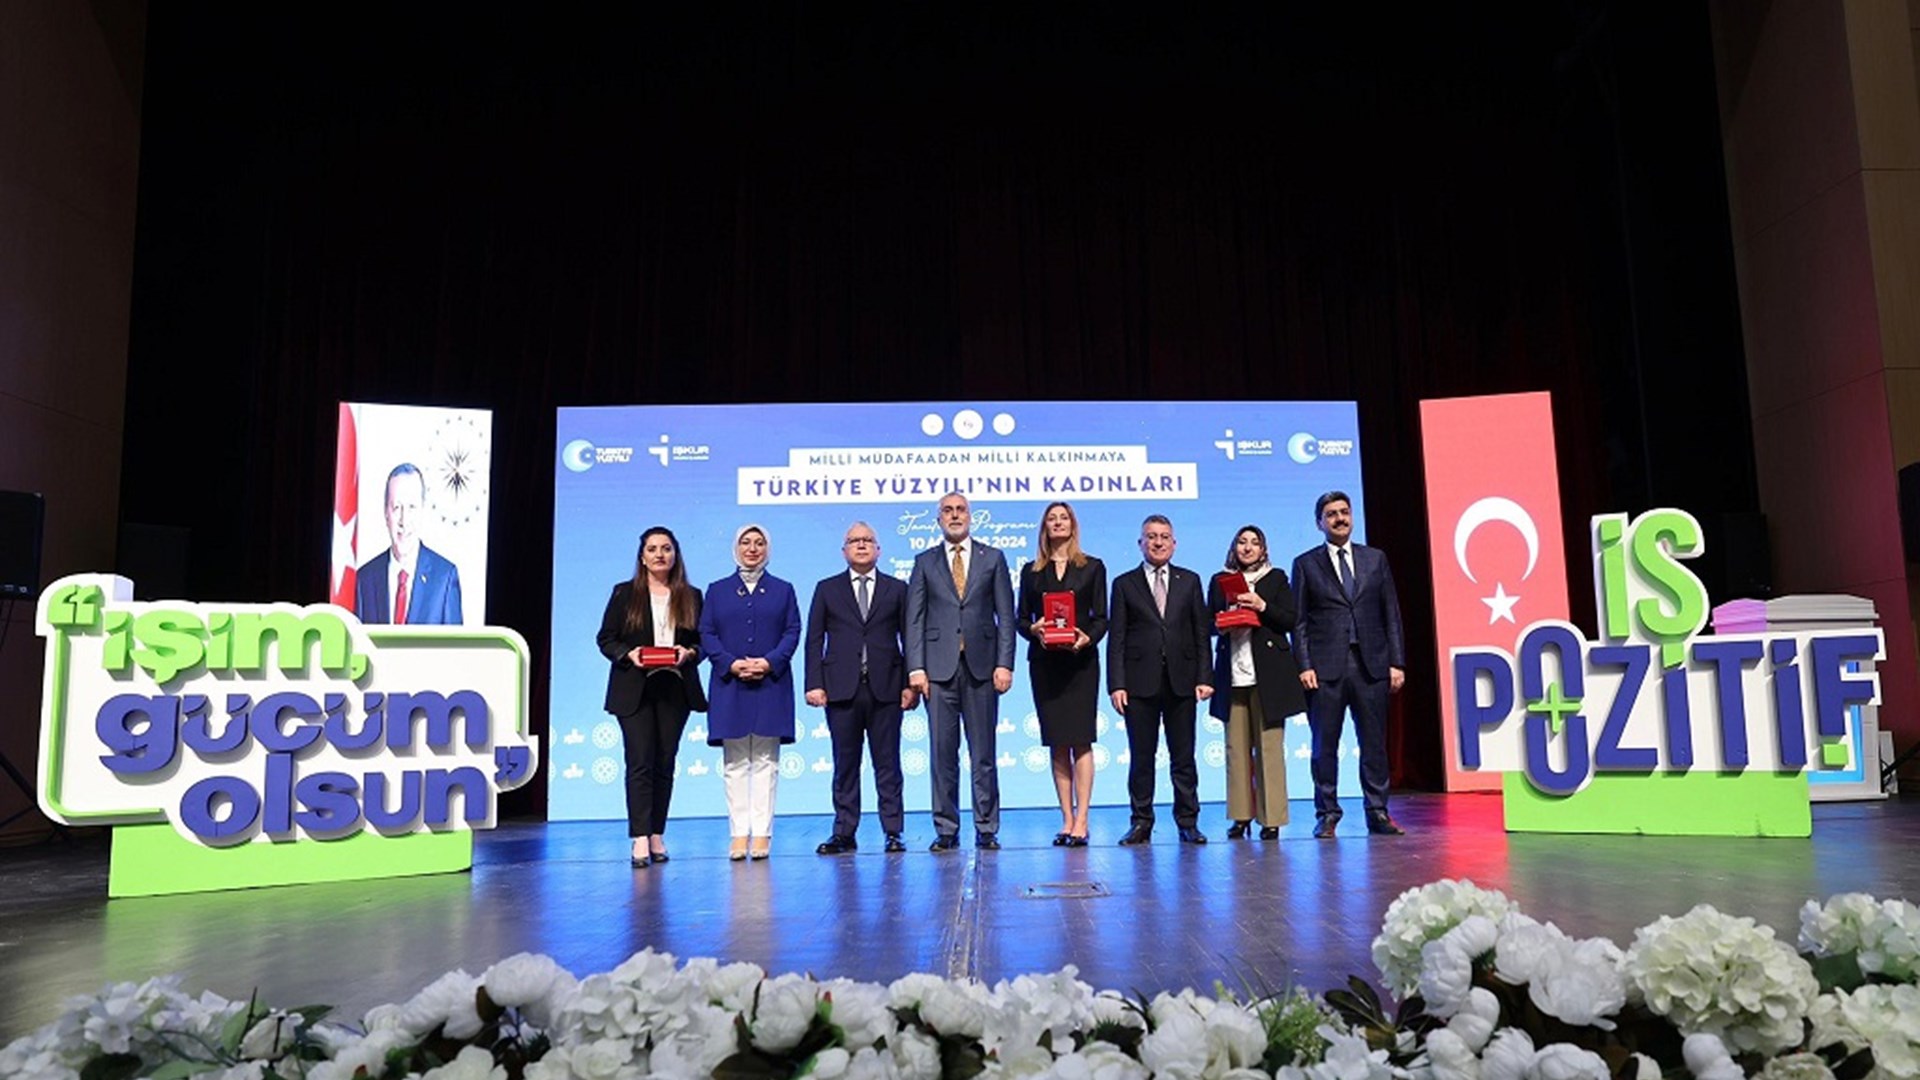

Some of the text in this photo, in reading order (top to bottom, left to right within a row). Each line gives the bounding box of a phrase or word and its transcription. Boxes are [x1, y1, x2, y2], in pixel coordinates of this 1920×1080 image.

[1026, 450, 1127, 463] KALKINMAYA
[753, 475, 862, 497] TÜRKİYE
[1042, 475, 1183, 492] KADINLARI
[909, 537, 924, 550] 10
[990, 536, 1028, 549] 2024
[95, 689, 490, 773] gücüm
